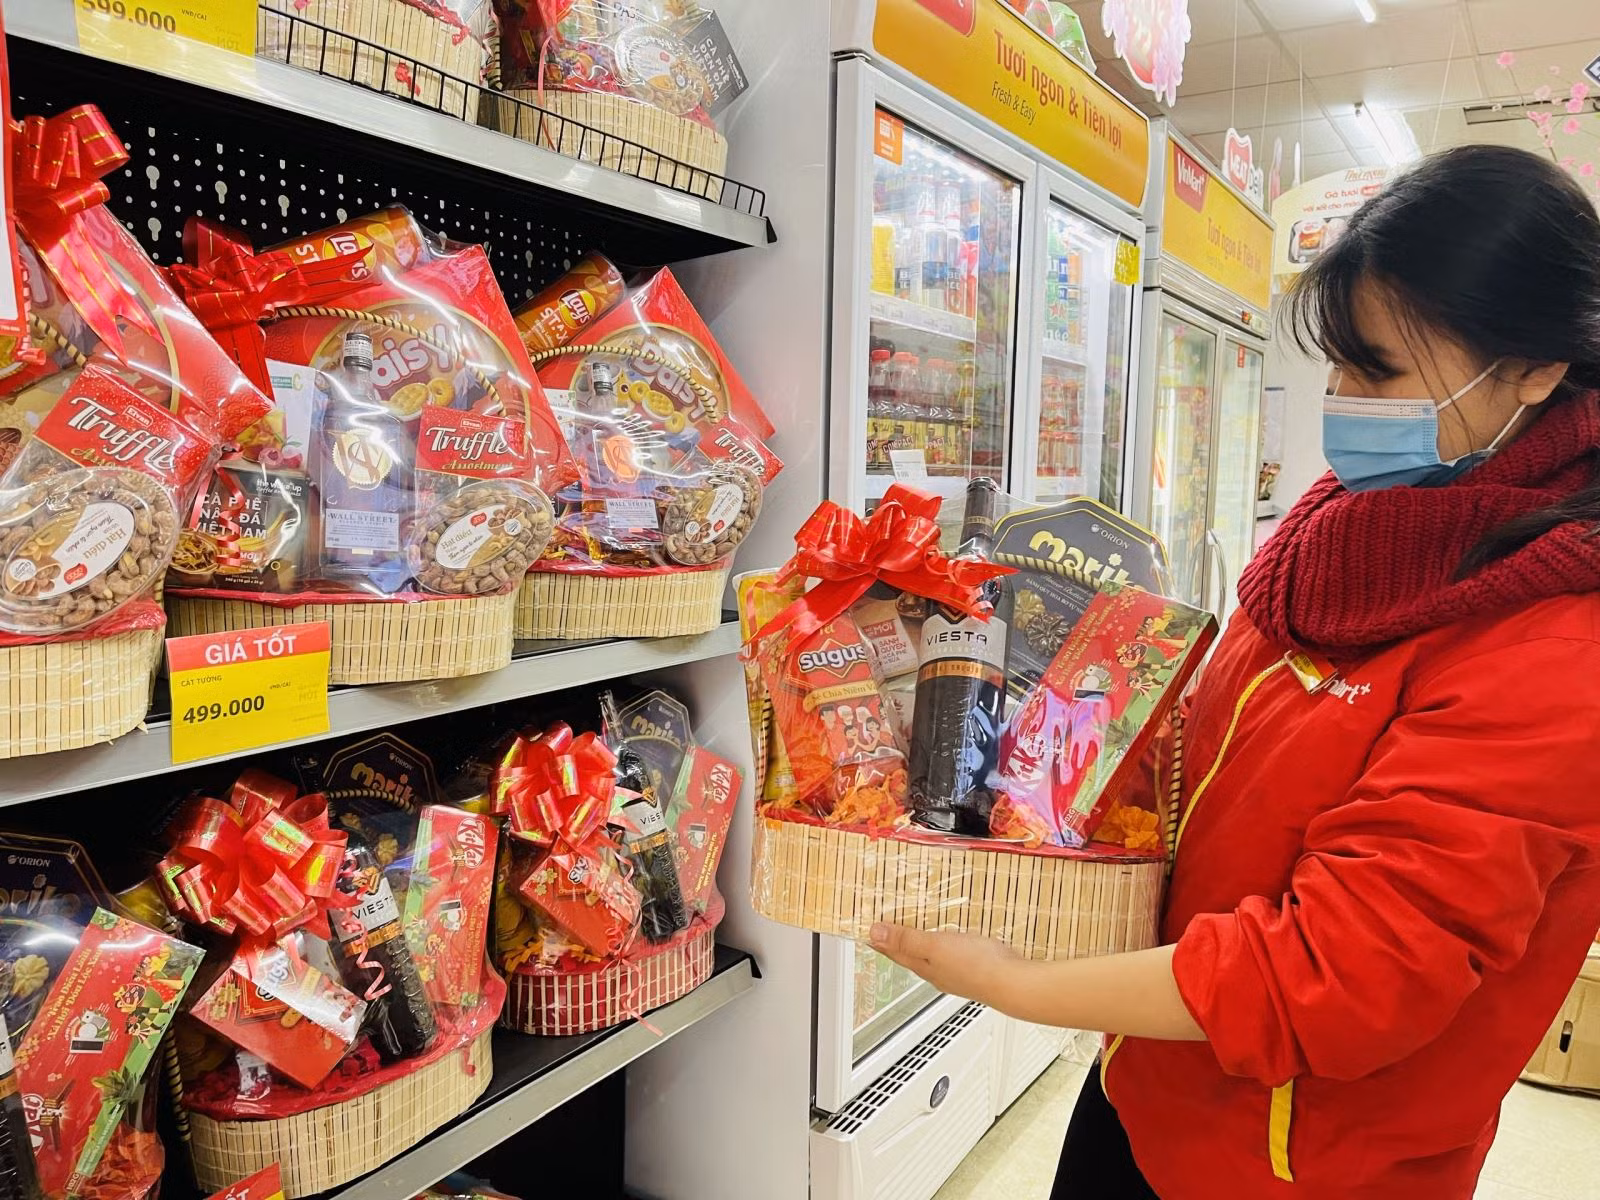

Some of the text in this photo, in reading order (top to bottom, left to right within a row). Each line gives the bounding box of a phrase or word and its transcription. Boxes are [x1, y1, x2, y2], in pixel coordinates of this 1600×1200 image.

[994, 29, 1026, 82] Tươi
[1032, 65, 1064, 107] ngon
[1069, 87, 1078, 119] &
[991, 81, 1037, 125] Fresh & Easy
[126, 407, 150, 425] Elvan
[68, 396, 177, 470] Truffle
[426, 427, 509, 460] Truffle
[239, 510, 261, 525] ĐÁ
[330, 512, 393, 523] WALL STREET
[1100, 529, 1130, 550] ORION
[205, 629, 297, 665] GIÁ TỐT
[927, 631, 987, 647] VIESTA
[800, 646, 864, 670] sugus
[183, 695, 265, 724] 499.000
[19, 856, 51, 868] ORION
[65, 1173, 80, 1191] 102G
